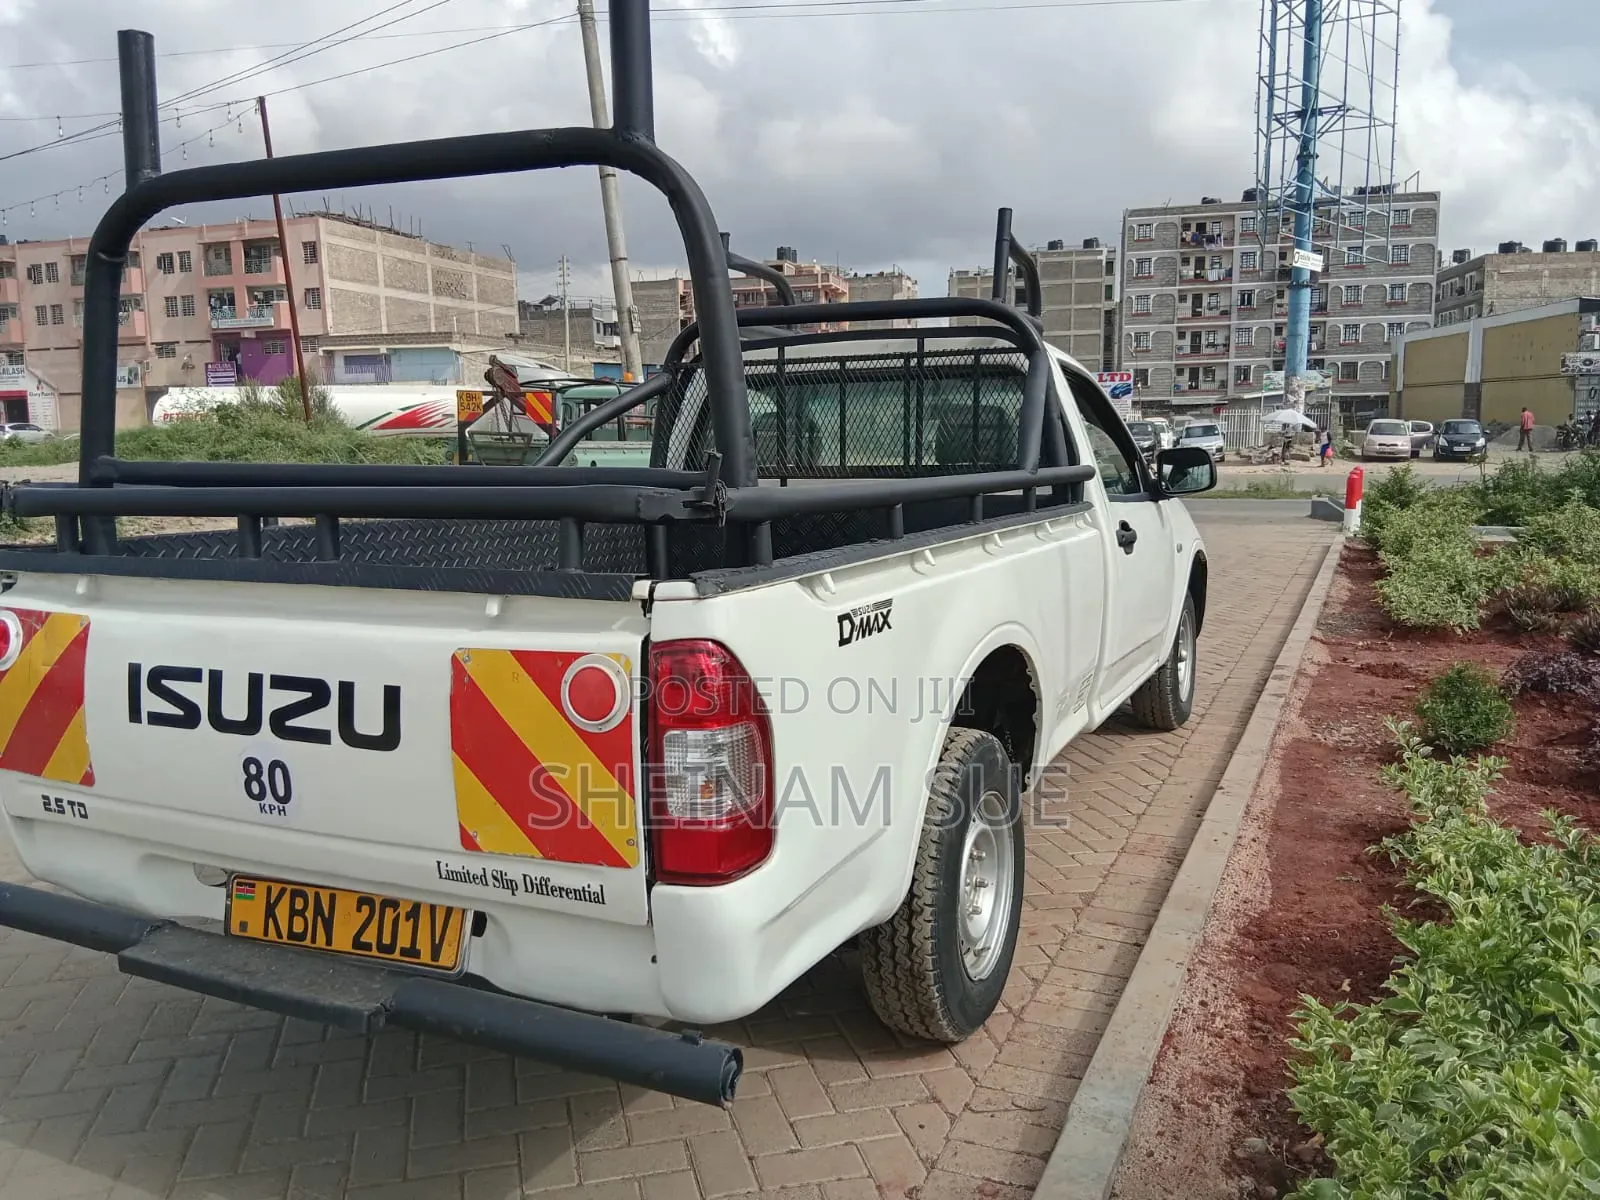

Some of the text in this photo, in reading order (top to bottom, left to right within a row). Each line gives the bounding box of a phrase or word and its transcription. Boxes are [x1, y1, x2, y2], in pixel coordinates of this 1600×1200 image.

[1097, 371, 1132, 383] LTD
[127, 661, 402, 752] ISUZU
[242, 756, 292, 805] 80
[41, 794, 89, 820] 2.5 TD
[258, 802, 288, 817] KPH
[435, 860, 607, 905] Limited Slip Differential
[262, 884, 454, 963] KBN 201V
